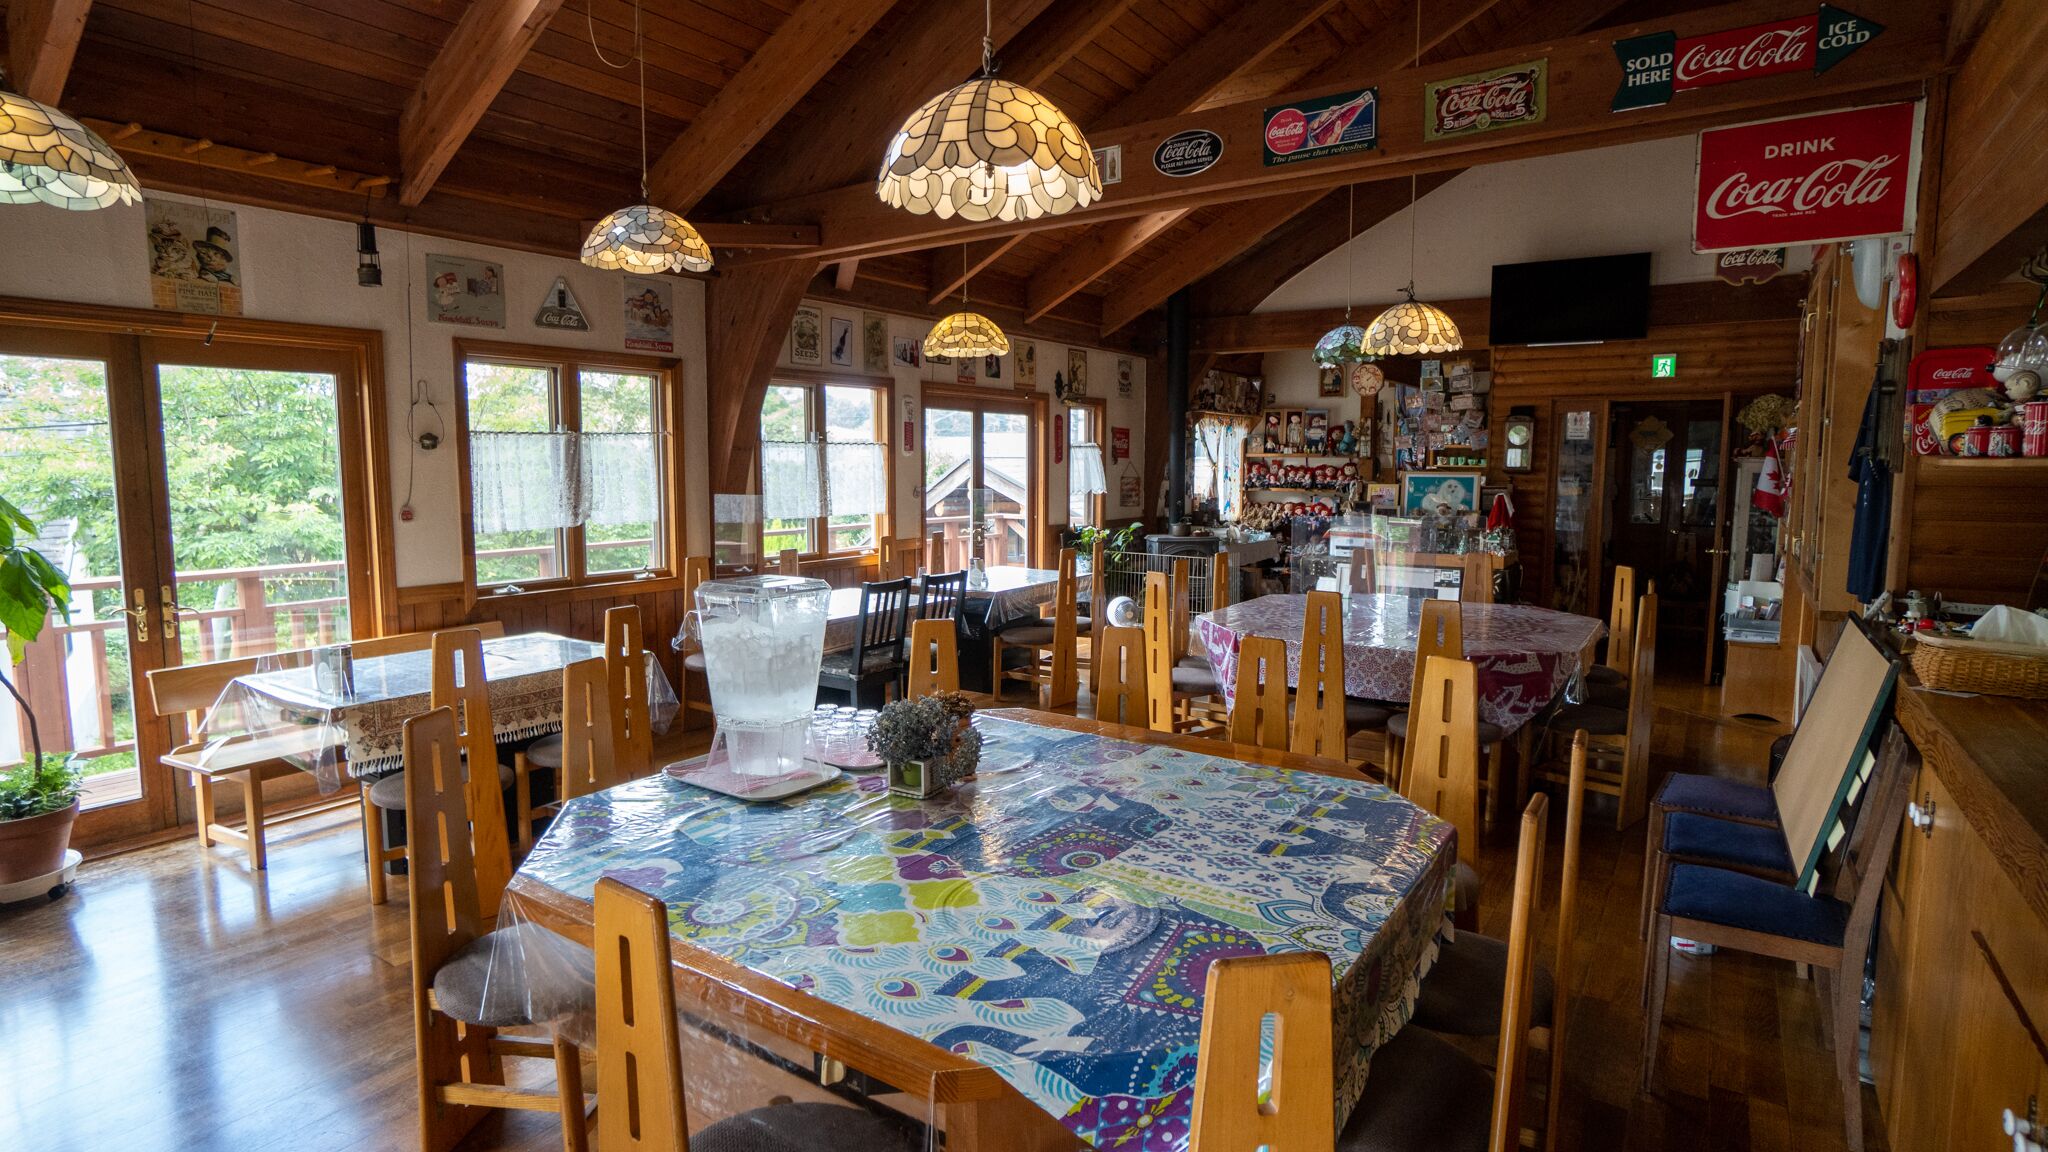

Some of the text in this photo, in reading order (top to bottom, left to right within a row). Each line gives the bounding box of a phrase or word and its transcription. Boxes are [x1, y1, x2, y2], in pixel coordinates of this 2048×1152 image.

[1829, 20, 1857, 37] ICE
[1819, 31, 1871, 50] COLD
[1626, 52, 1673, 72] SOLD
[1675, 25, 1814, 82] Coca-Cola
[1628, 68, 1672, 87] HERE
[1441, 80, 1530, 117] Coca-Cola
[1269, 121, 1304, 139] Coca-Cola
[1161, 138, 1212, 163] Coca-Cola
[1764, 136, 1836, 159] DRINK
[1272, 155, 1287, 163] The
[1705, 154, 1901, 219] Coca-Cola
[1932, 367, 1975, 380] Coca-Cola
